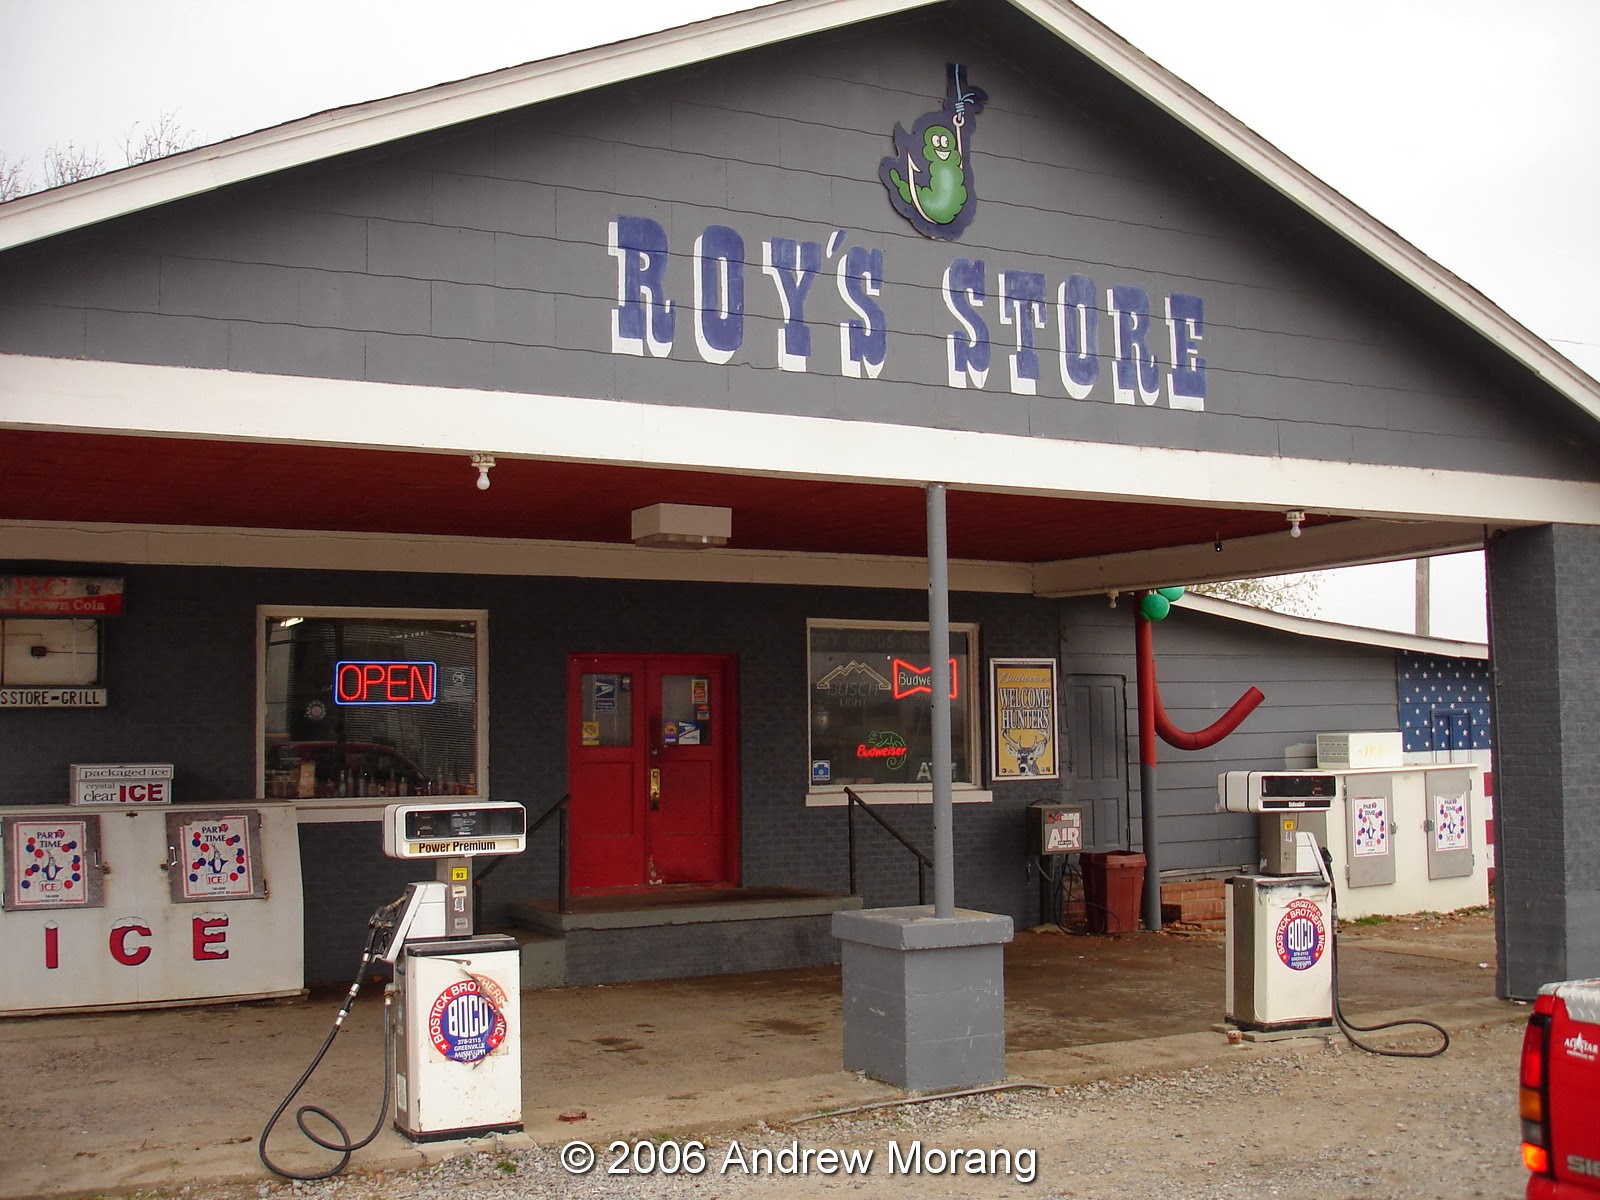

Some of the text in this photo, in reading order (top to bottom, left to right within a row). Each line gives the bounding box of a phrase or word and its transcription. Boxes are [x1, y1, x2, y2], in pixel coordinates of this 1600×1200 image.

[608, 216, 1206, 411] ROY'S STORE
[14, 577, 68, 596] RC
[72, 599, 105, 611] Cola
[338, 664, 433, 701] OPEN
[899, 671, 931, 686] Budwe
[1000, 672, 1051, 684] Budweiser
[827, 682, 879, 697] BUSCH
[999, 688, 1050, 709] WELCOME
[1002, 709, 1049, 729] HUNTERS
[857, 744, 907, 758] Budweiser
[84, 768, 168, 778] packaged ice
[84, 783, 163, 802] clear ICE
[86, 782, 115, 791] crystal
[37, 828, 65, 840] PARTY
[201, 824, 228, 834] PARTY
[39, 840, 62, 848] TIME
[204, 834, 226, 843] TIME
[1048, 828, 1080, 849] AIR
[418, 841, 496, 853] Power Premium
[40, 882, 57, 891] ICE
[207, 875, 223, 884] ICE
[1277, 915, 1291, 955] BOSTICK
[1290, 908, 1323, 934] BROTHERS
[1288, 918, 1313, 951] BOCO
[45, 912, 229, 968] ICE
[430, 993, 451, 1044] BOSTICK
[448, 995, 489, 1038] BOCO
